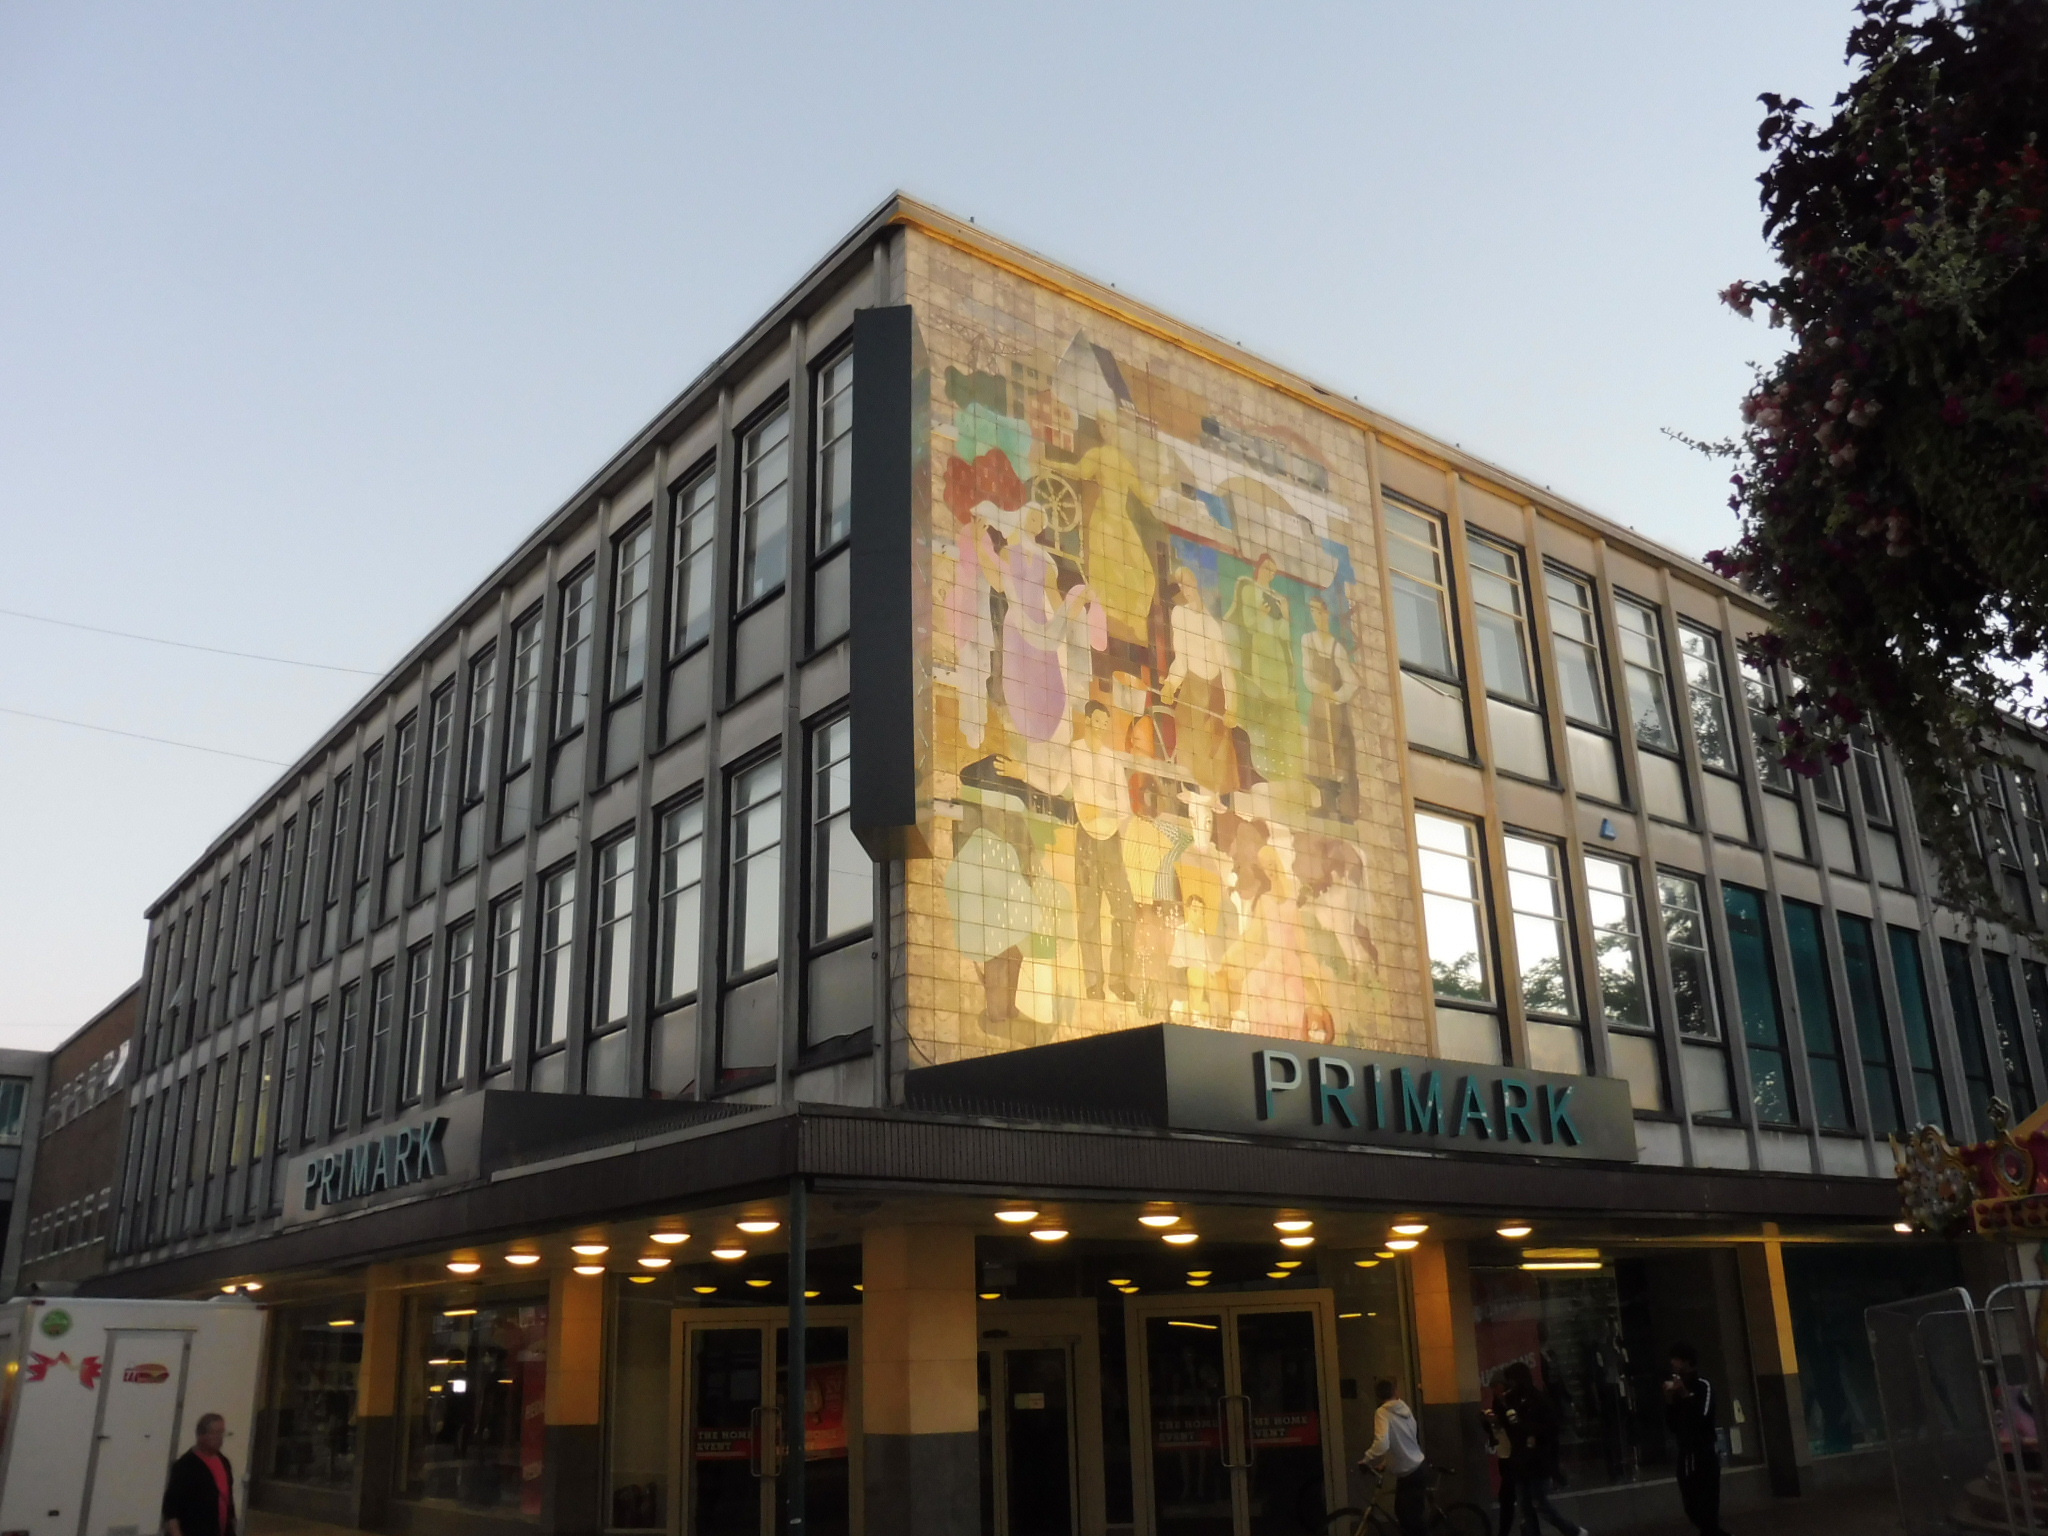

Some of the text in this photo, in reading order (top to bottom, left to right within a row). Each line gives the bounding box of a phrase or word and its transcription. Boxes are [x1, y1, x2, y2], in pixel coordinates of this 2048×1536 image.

[1254, 1049, 1582, 1146] PRIMARK
[304, 1117, 449, 1211] PRIMARK
[1159, 1420, 1181, 1430] THE
[1273, 1415, 1308, 1426] HOME
[698, 1430, 719, 1440] THE
[1159, 1431, 1195, 1442] EVENT
[697, 1441, 732, 1451] EVENT
